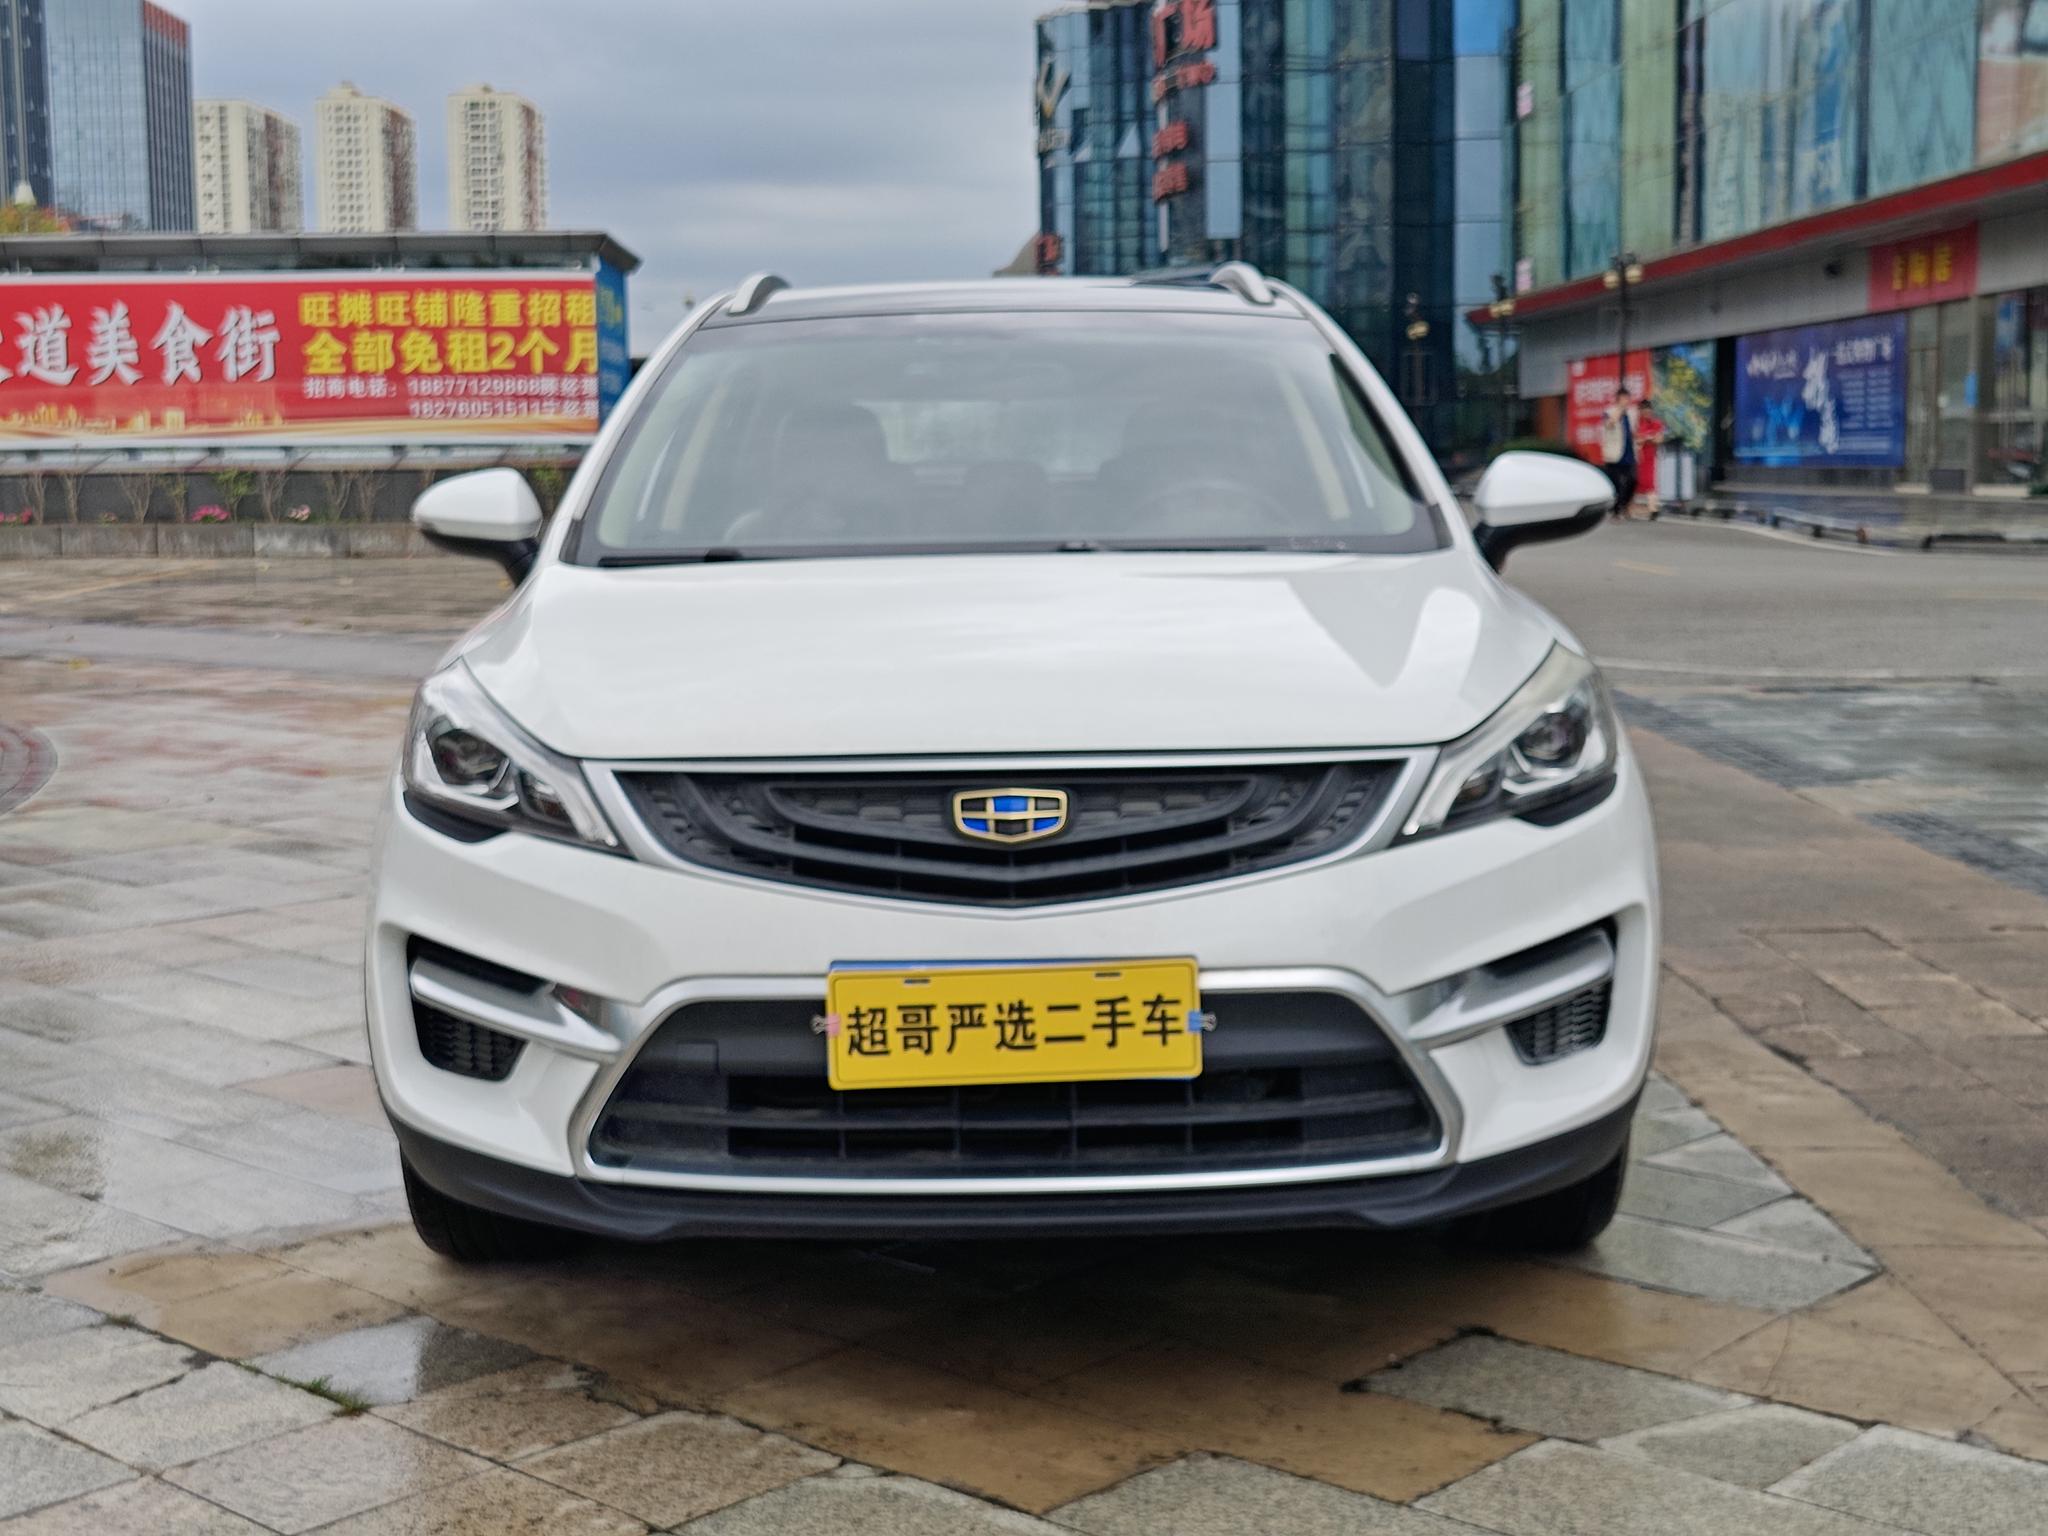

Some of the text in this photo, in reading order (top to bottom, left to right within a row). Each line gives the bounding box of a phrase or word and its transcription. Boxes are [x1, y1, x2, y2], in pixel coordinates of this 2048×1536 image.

[299, 291, 597, 328] 旺摊旺铺隆重招租
[0, 299, 281, 386] 道美食街
[302, 329, 599, 375] 全部免租2个月
[846, 994, 1185, 1056] 超哥严选二手车
